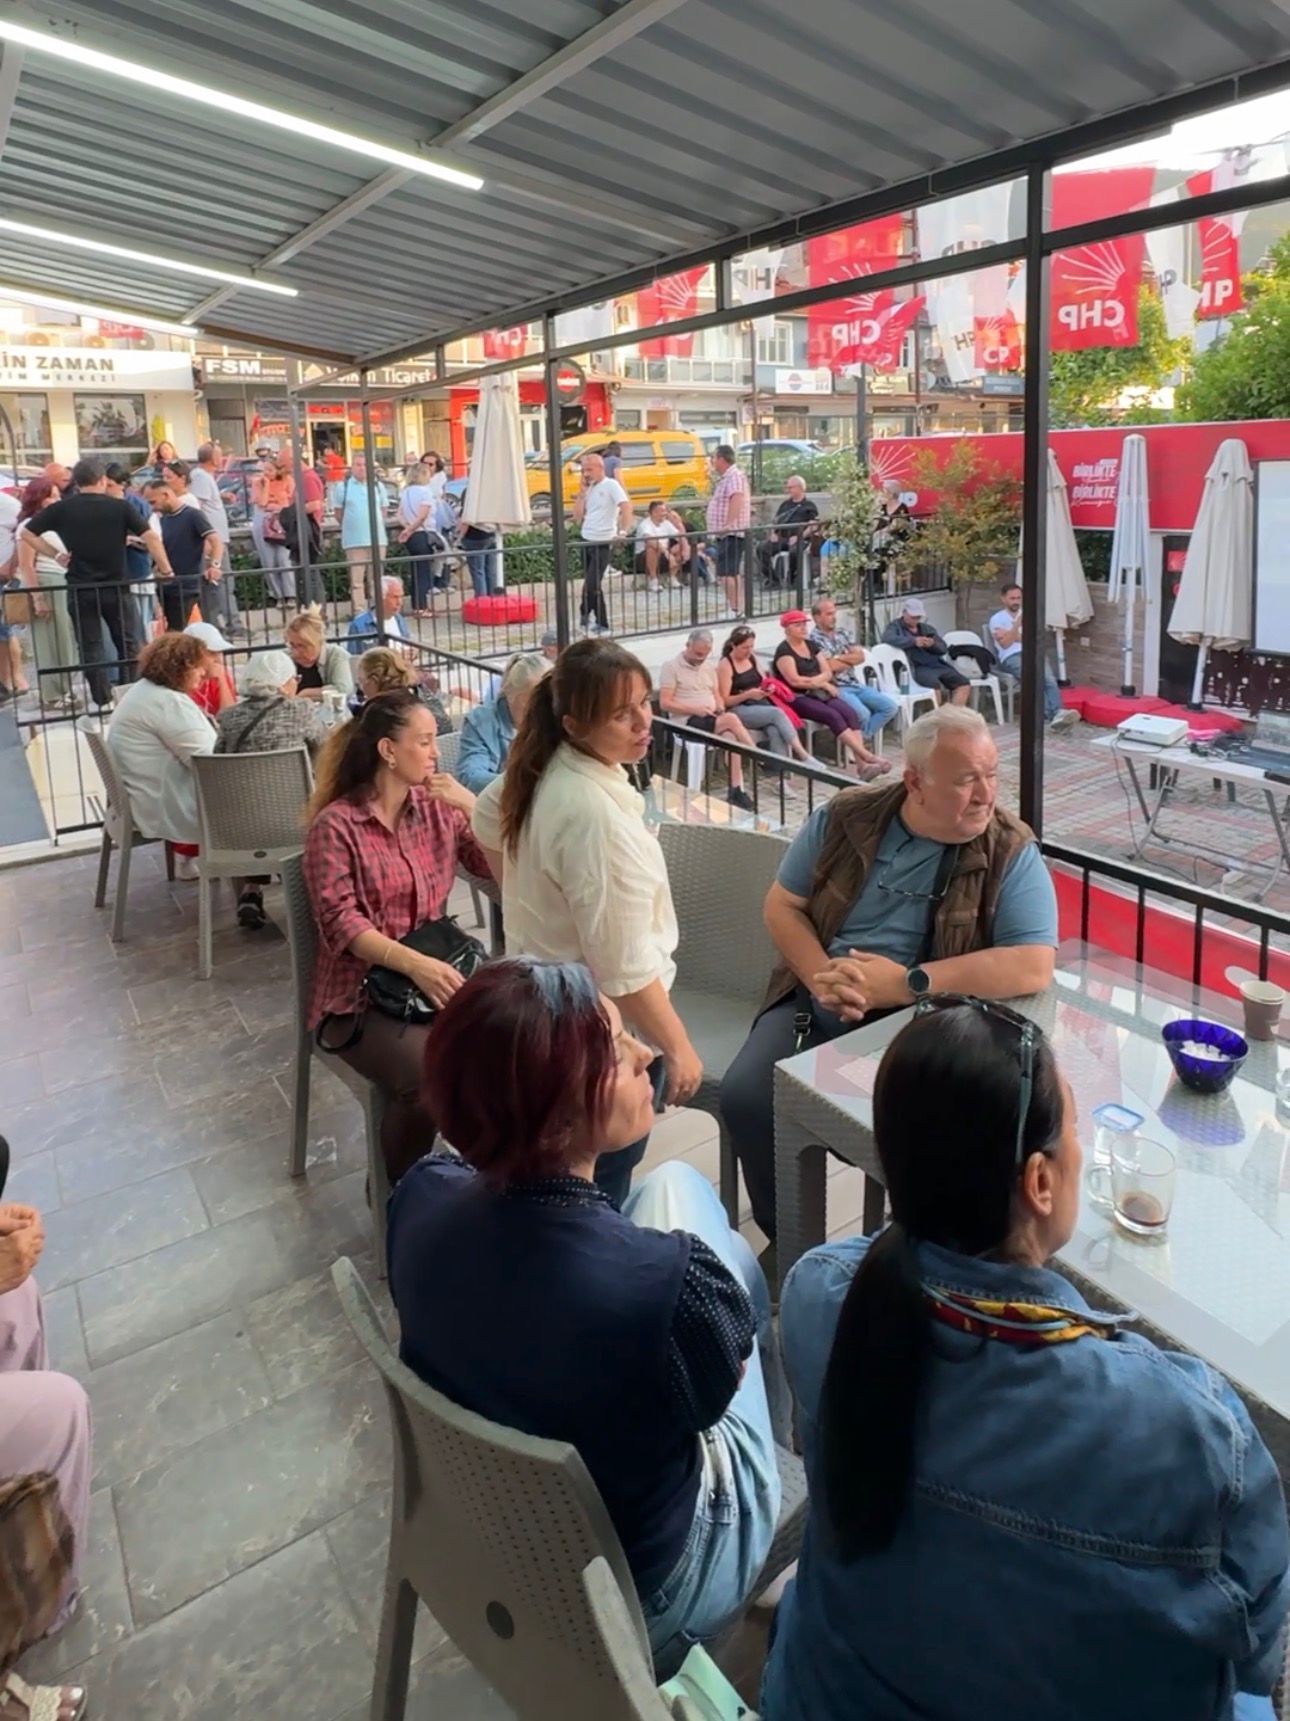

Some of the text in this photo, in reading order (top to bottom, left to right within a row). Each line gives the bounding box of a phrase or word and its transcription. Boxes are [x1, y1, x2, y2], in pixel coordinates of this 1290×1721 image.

[35, 356, 114, 371] ZAMAN
[205, 359, 261, 374] FSM
[382, 367, 431, 383] Ticaret
